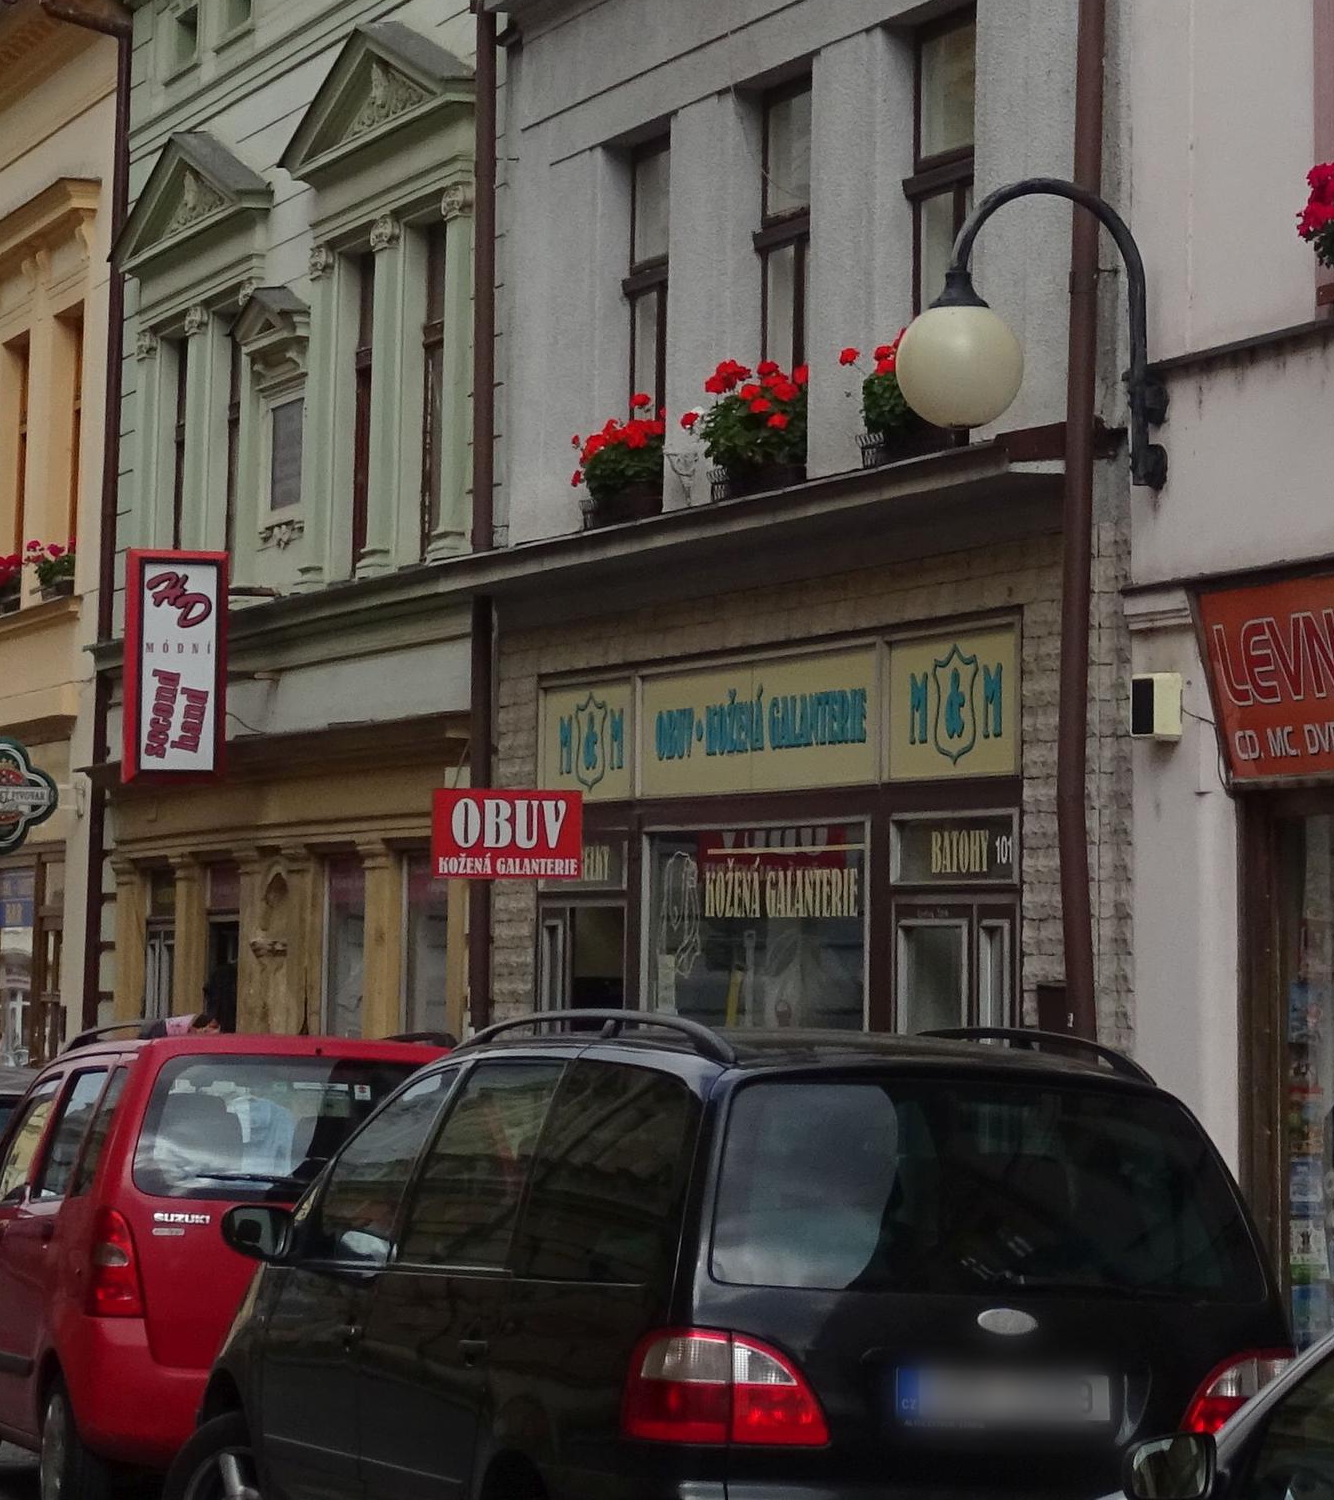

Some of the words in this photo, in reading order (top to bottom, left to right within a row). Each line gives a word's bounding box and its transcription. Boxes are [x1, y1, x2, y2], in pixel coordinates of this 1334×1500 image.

[146, 571, 213, 629] HD
[145, 638, 212, 655] MÓDNÍ
[144, 668, 181, 759] second
[170, 687, 210, 754] hand
[655, 706, 695, 761] OBUV
[705, 683, 765, 756] KOŽENÁ
[768, 687, 868, 751] GALANTERIE
[908, 671, 928, 744] M
[982, 662, 1003, 739] M
[559, 714, 573, 775] M
[609, 707, 624, 770] M
[452, 798, 566, 849] OBUV
[931, 829, 989, 873] BATOHY
[995, 835, 1012, 864] 101
[438, 853, 492, 875] KOŽENÁ
[496, 857, 578, 876] GALANTERIE
[705, 857, 761, 918] KOŽENÁ
[767, 868, 859, 918] GALANTERIE
[153, 1212, 211, 1224] SUZUKI
